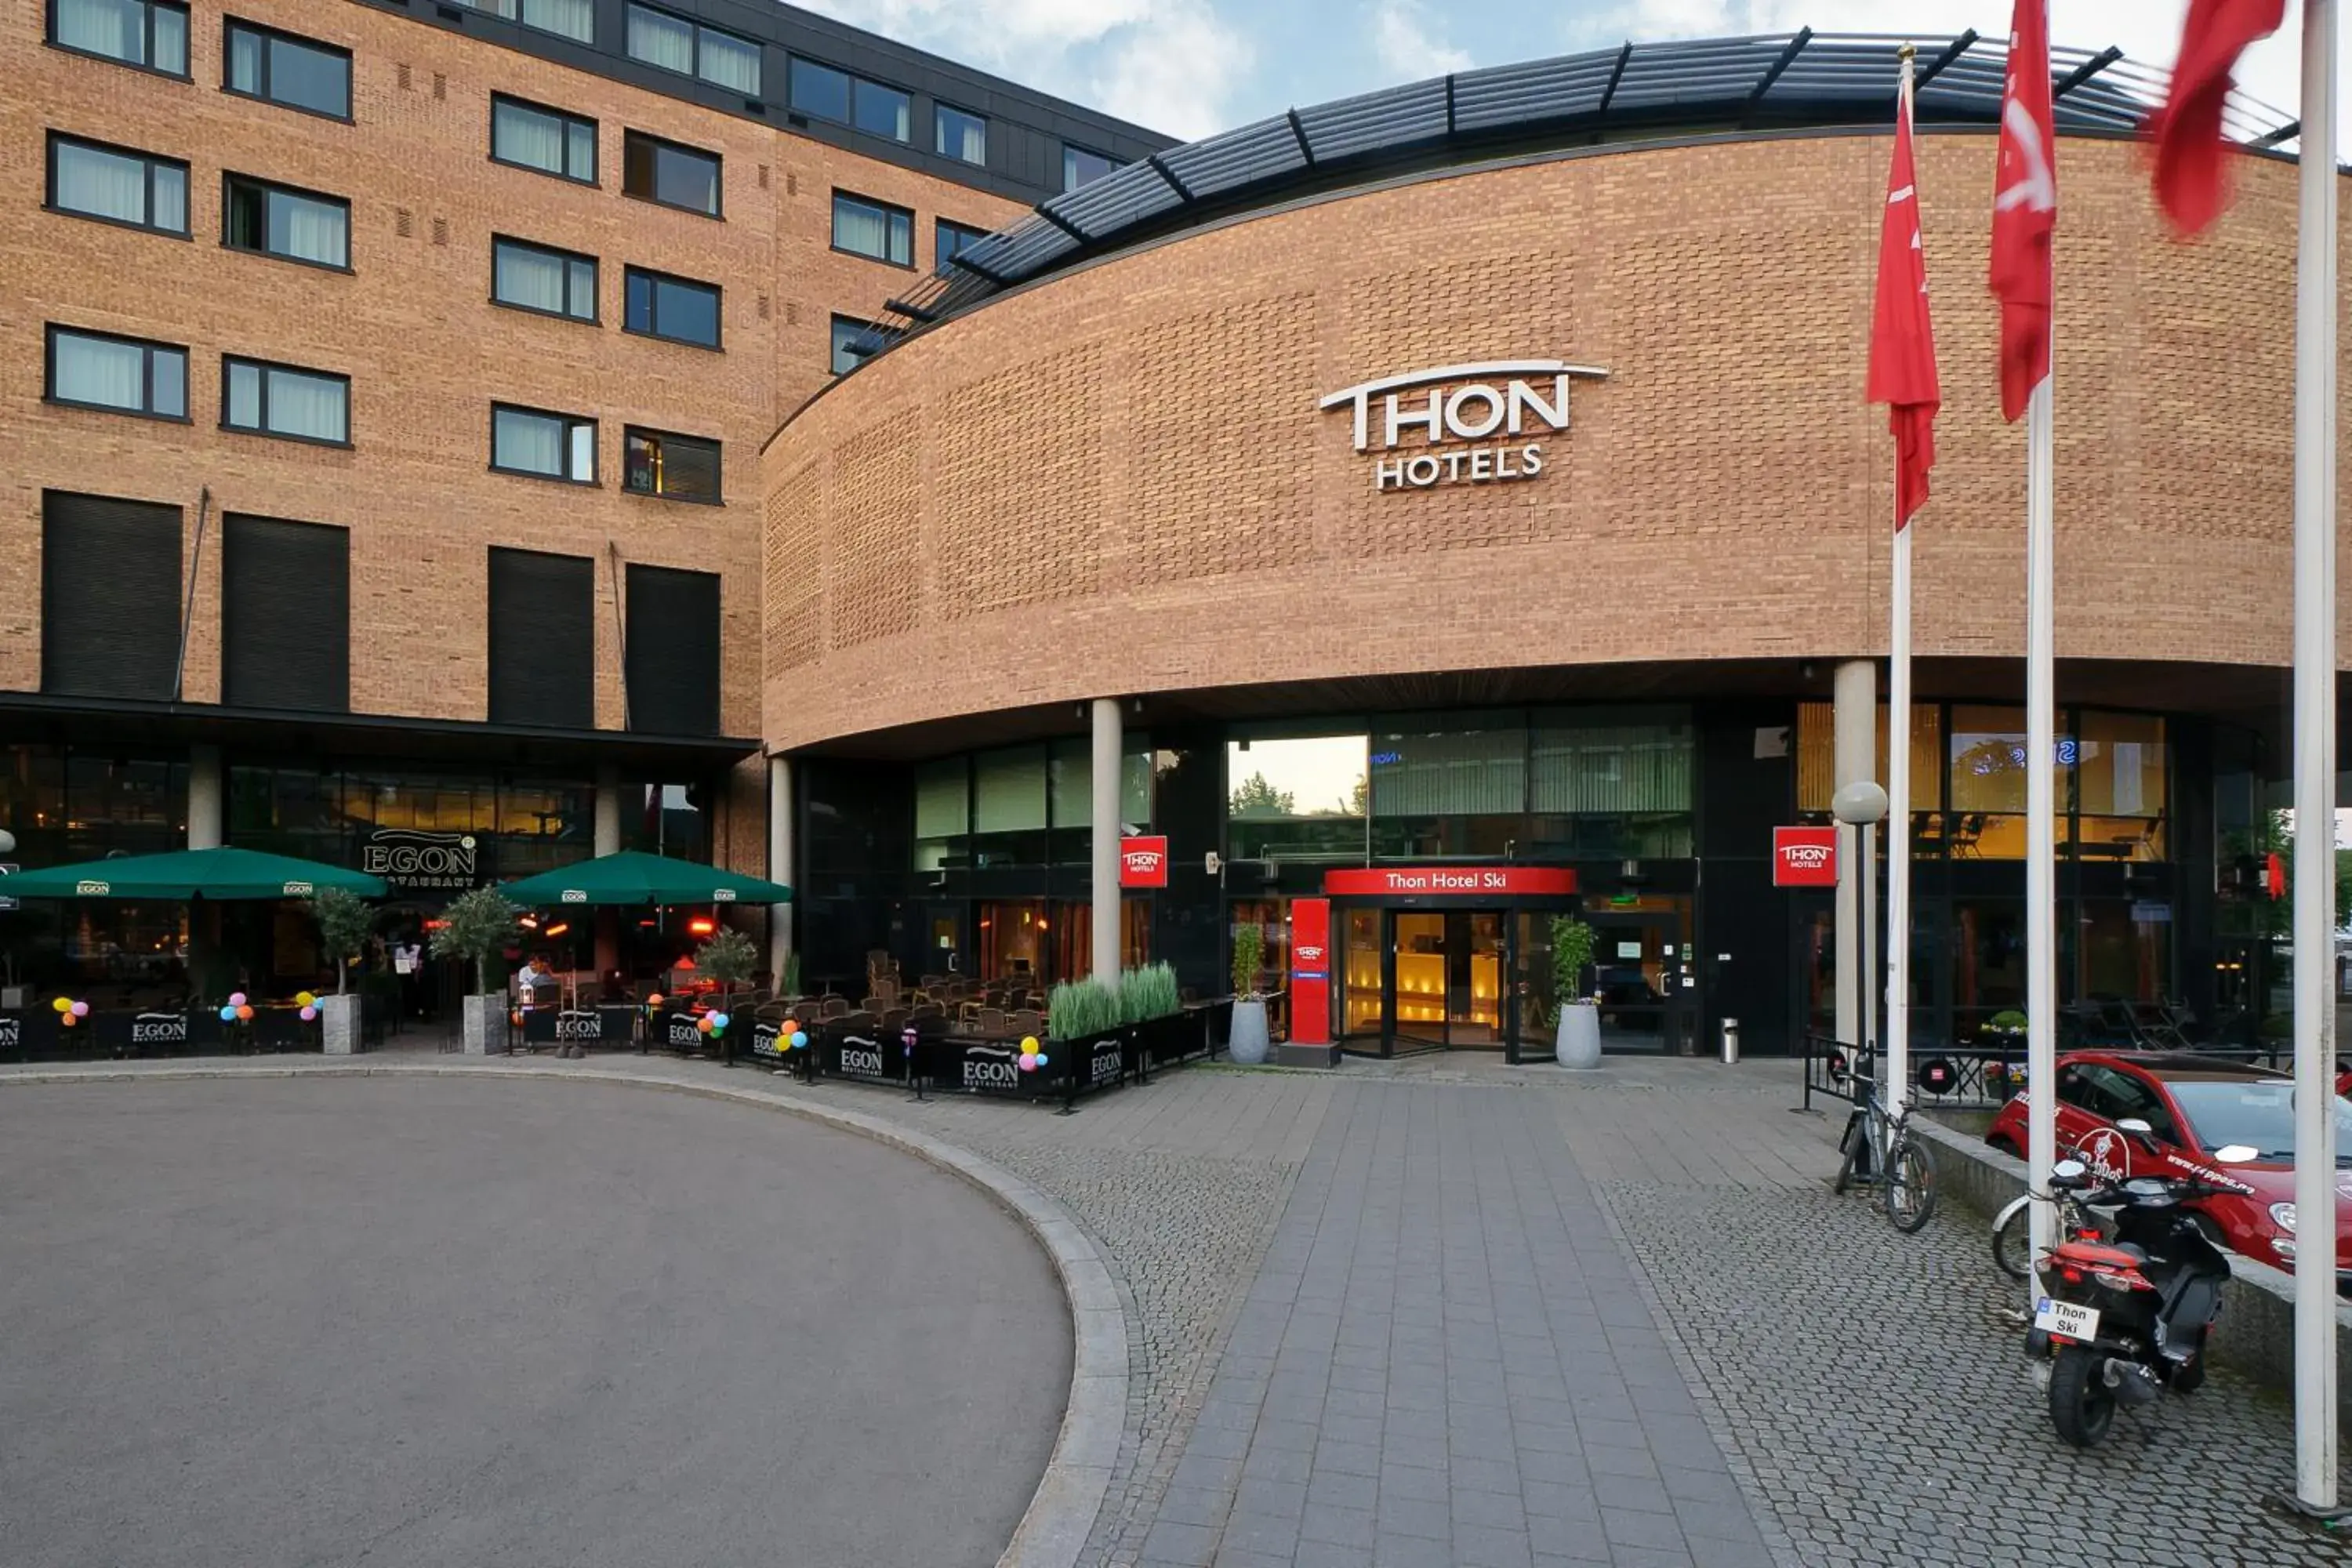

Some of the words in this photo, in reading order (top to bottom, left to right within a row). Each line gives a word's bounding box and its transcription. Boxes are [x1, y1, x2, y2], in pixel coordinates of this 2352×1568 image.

[1320, 360, 1609, 452] THON
[1376, 444, 1542, 489] HOTELS
[363, 846, 477, 874] EGON
[1123, 851, 1163, 866] THON
[1779, 844, 1833, 860] THON
[1386, 873, 1426, 887] Thon
[1432, 873, 1478, 887] Hotel
[1484, 873, 1506, 887] Ski
[133, 1023, 187, 1037] EGON
[555, 1021, 601, 1033] EGON
[670, 1025, 702, 1041] EGON
[841, 1049, 882, 1069] EGON
[1092, 1052, 1121, 1074] EGON
[963, 1062, 1018, 1082] EGON
[2055, 1303, 2087, 1319] Thon
[2056, 1319, 2078, 1334] Ski
